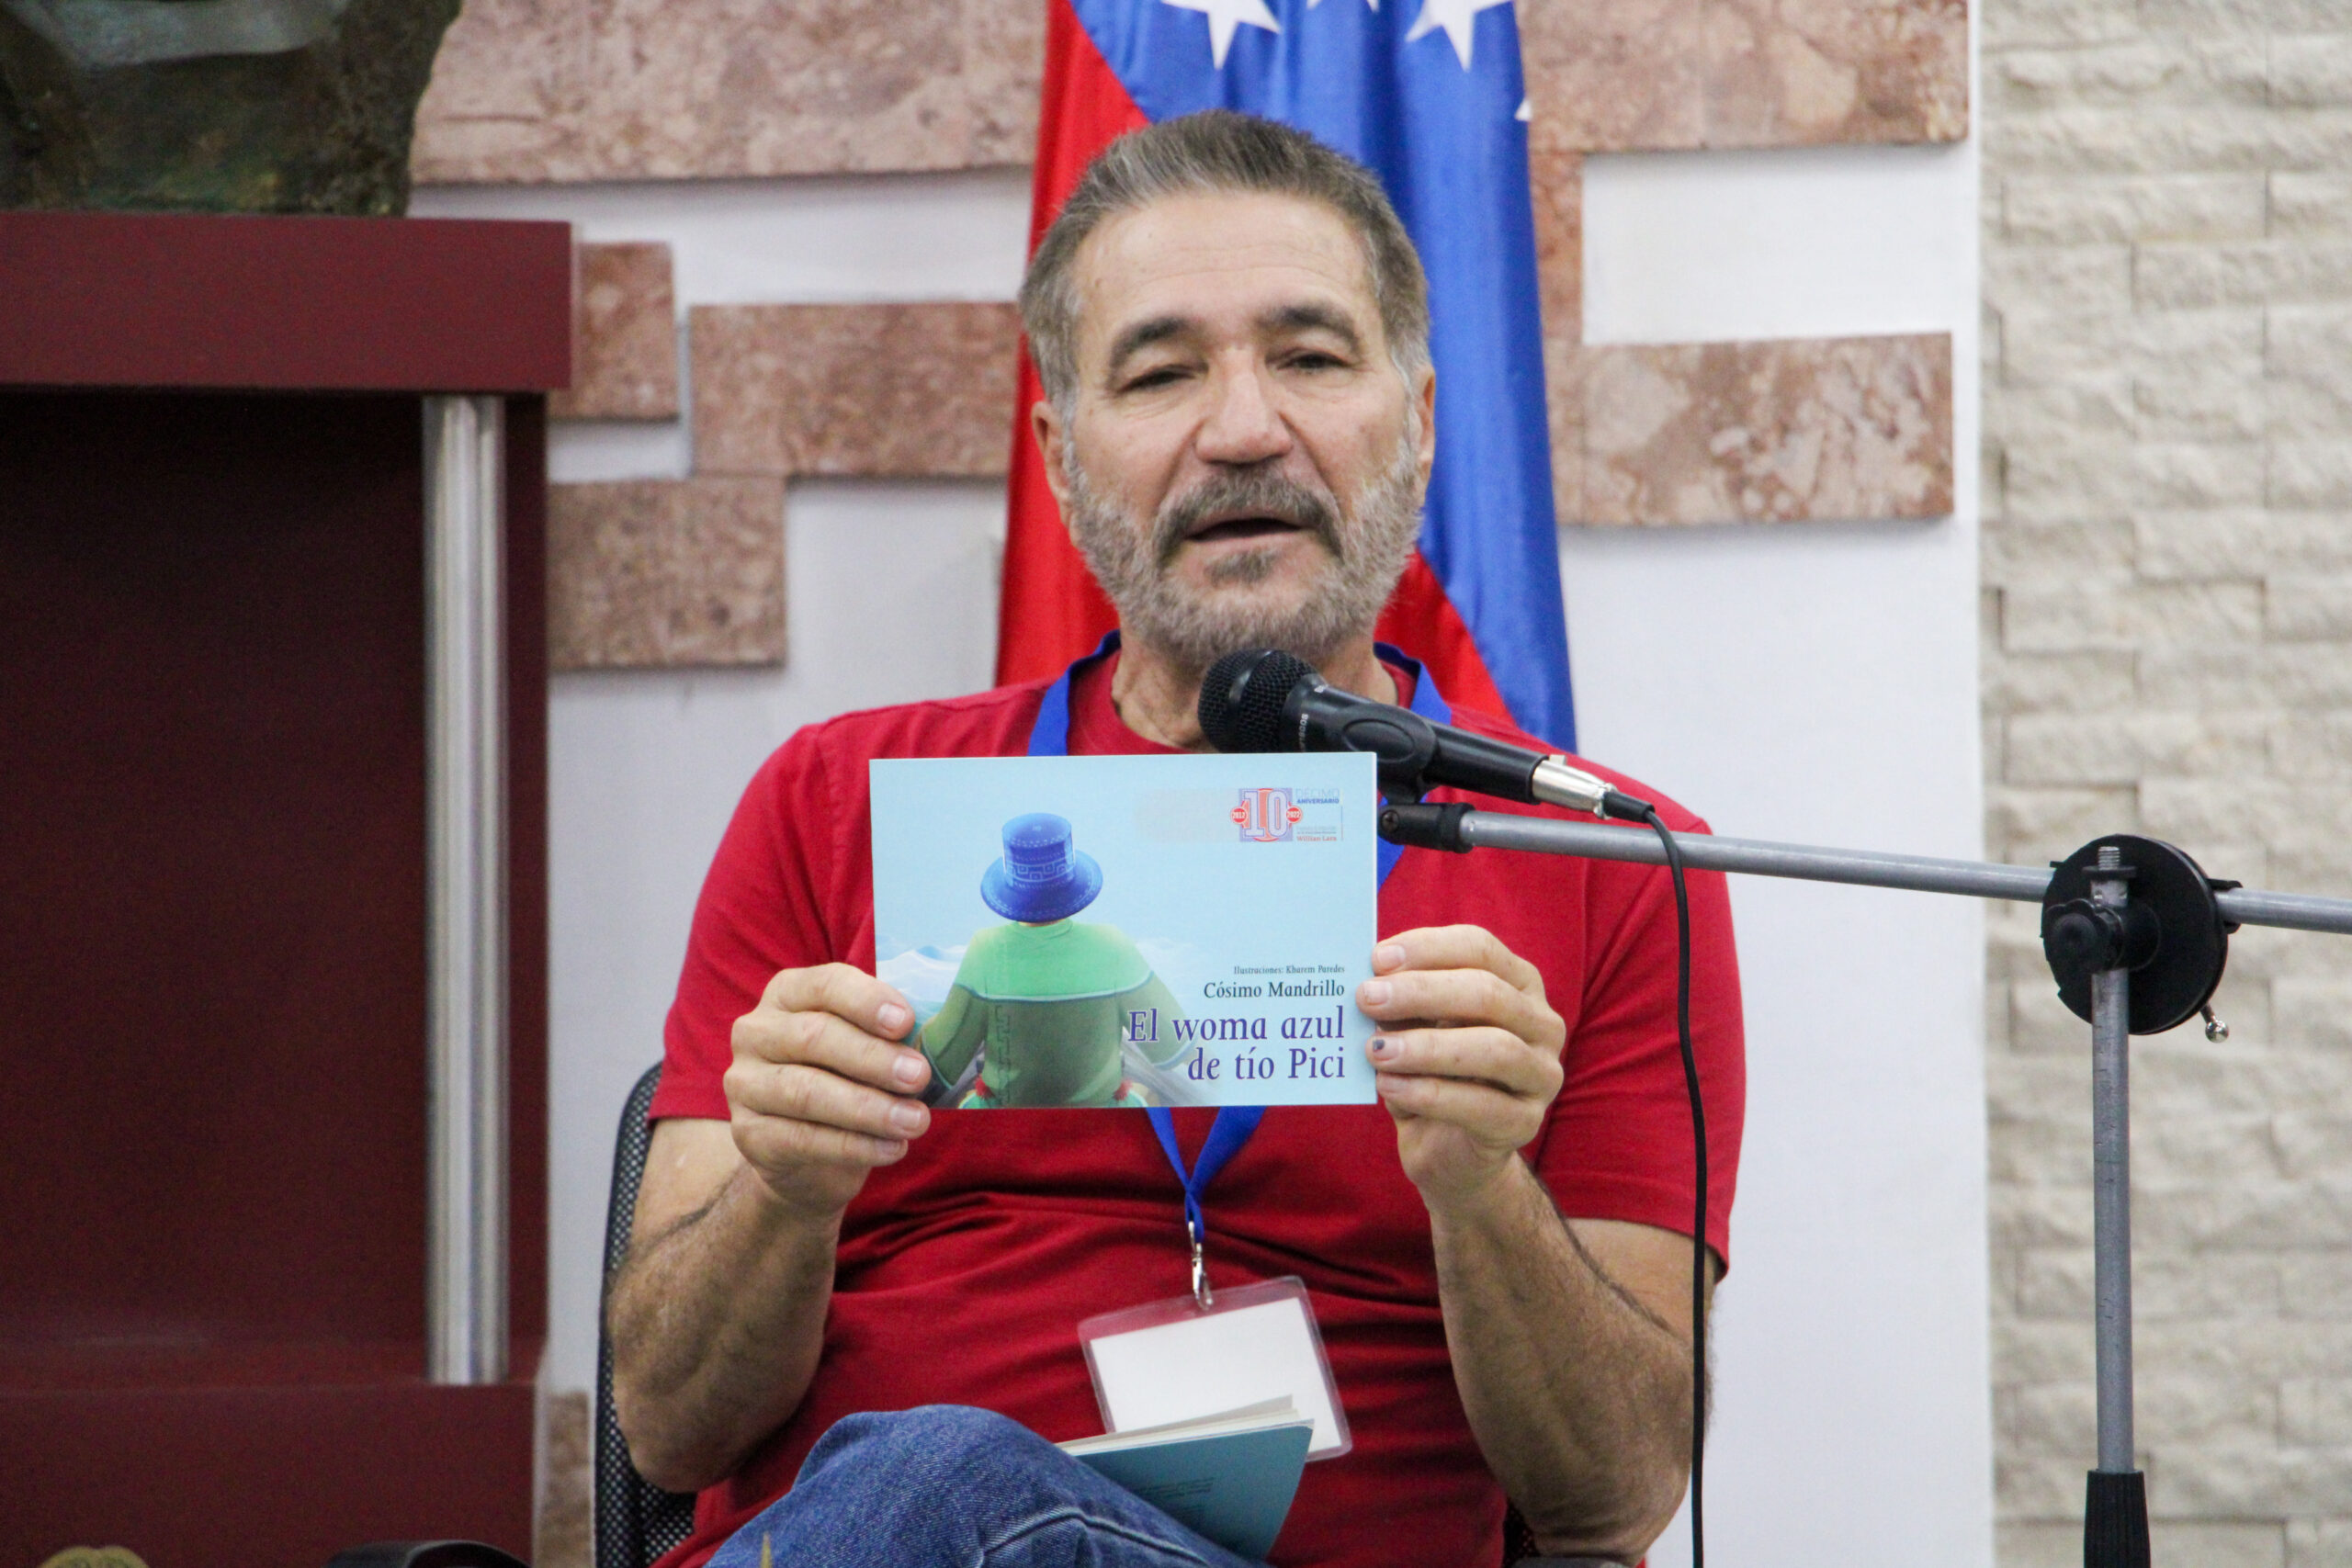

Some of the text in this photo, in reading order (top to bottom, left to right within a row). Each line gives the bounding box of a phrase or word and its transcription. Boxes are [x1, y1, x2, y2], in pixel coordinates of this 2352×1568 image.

[1244, 790, 1288, 837] 10
[1233, 965, 1284, 976] Ilustraciones:
[1317, 964, 1345, 974] Paredes
[1204, 978, 1345, 998] Cósimo Mandrillo
[1127, 1005, 1345, 1043] El woma azul
[1187, 1046, 1346, 1081] de tío Pici
